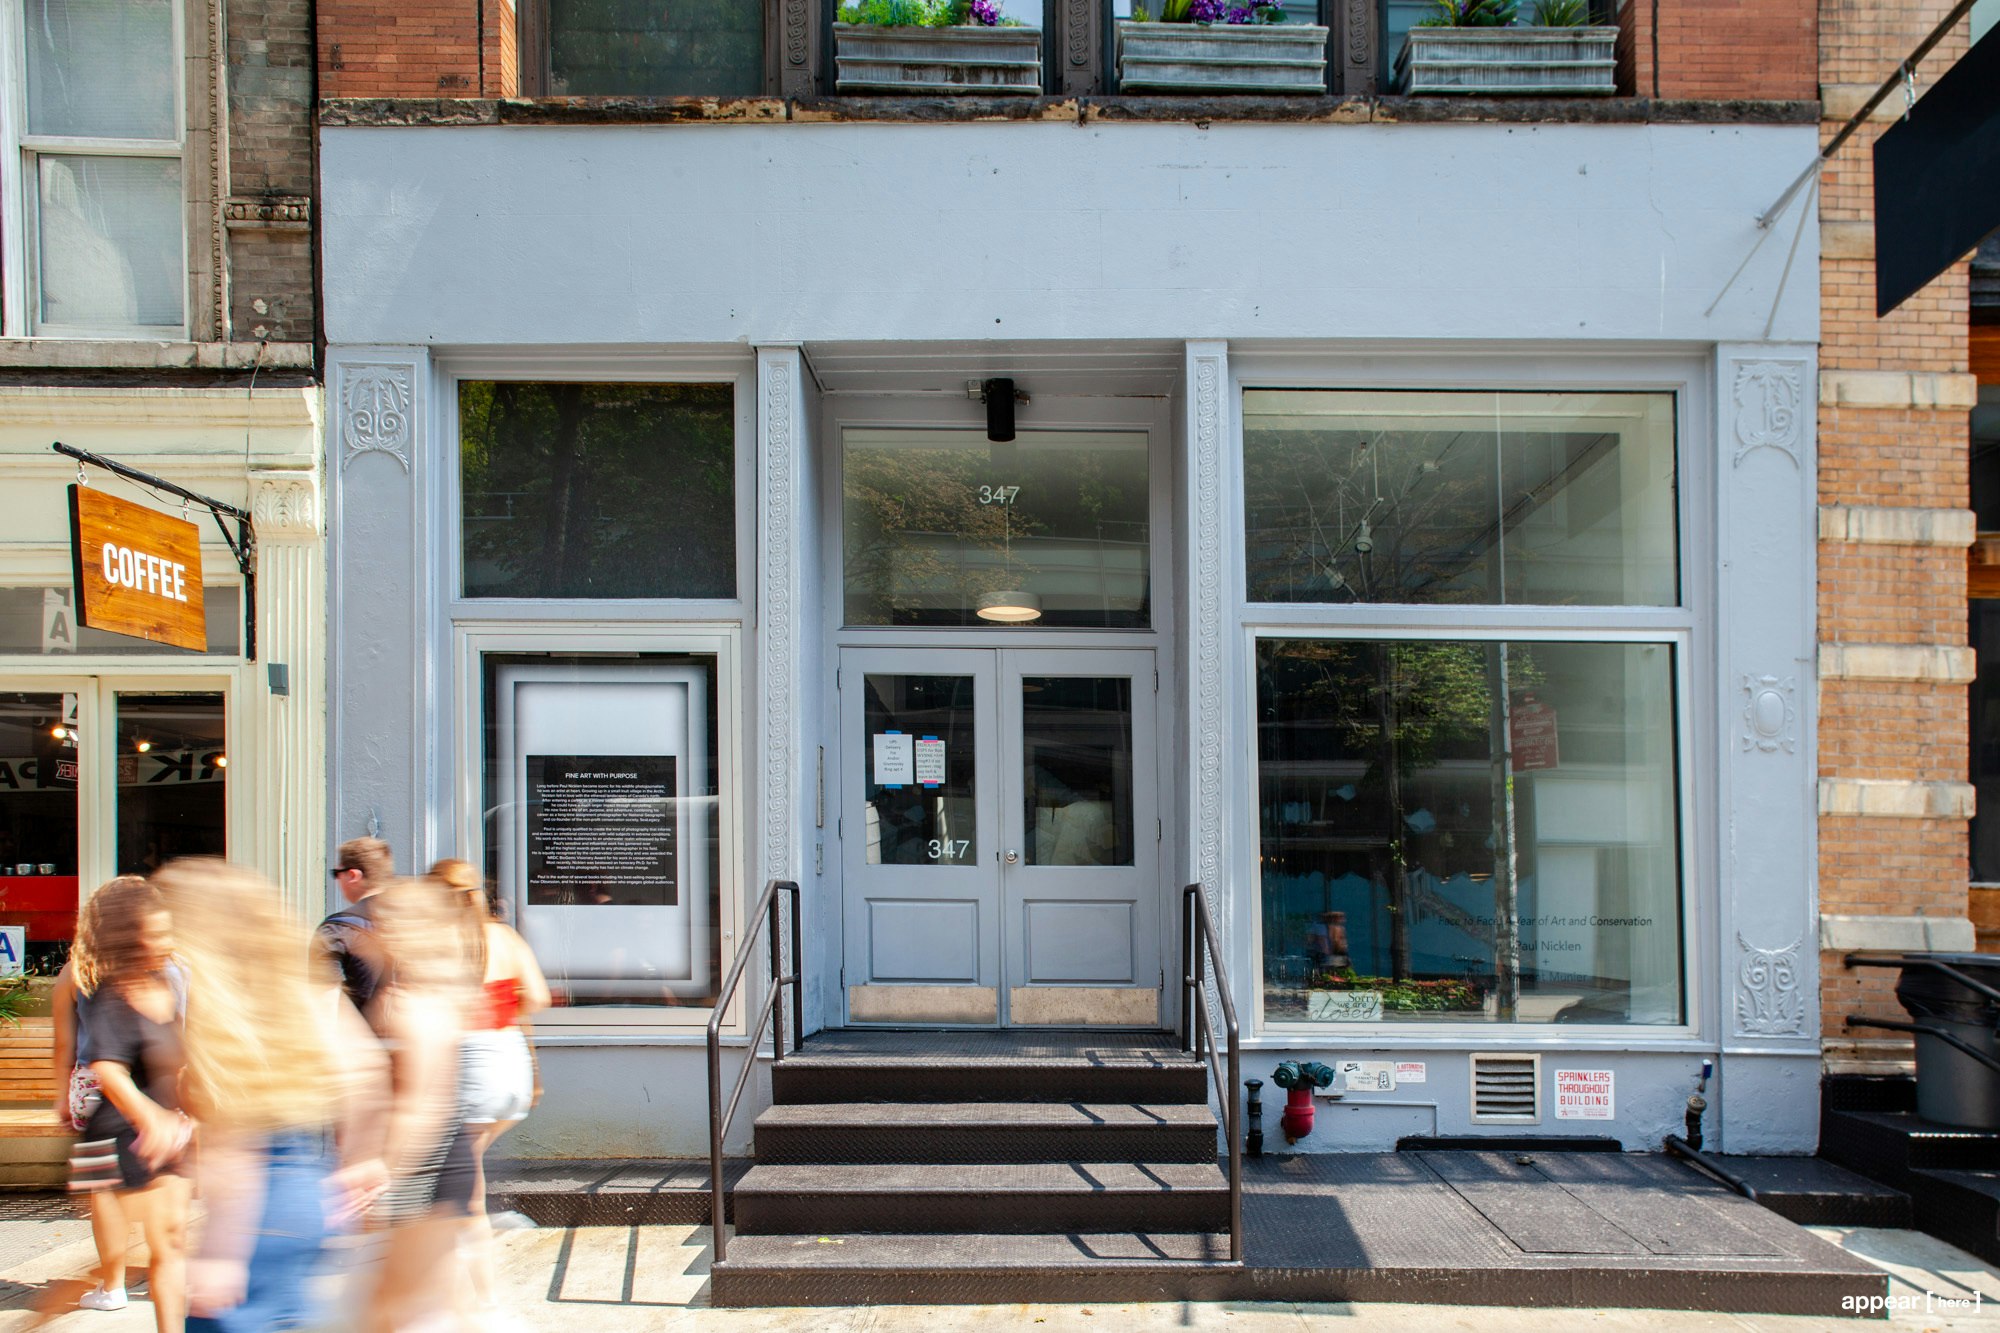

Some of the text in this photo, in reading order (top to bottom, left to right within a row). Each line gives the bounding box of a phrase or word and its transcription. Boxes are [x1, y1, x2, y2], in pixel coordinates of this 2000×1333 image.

[979, 485, 1020, 504] 347
[102, 542, 188, 603] COFFEE
[928, 839, 970, 859] 347
[1538, 916, 1550, 927] of
[1551, 915, 1566, 926] Art
[1569, 915, 1587, 926] and
[1589, 915, 1653, 927] Conservation
[1541, 940, 1582, 951] Nicklen
[1550, 971, 1588, 983] Munier
[1348, 991, 1375, 1004] Sorry
[1558, 1072, 1610, 1082] SPRINKLERS
[1558, 1083, 1610, 1094] THROUGHOUT
[1560, 1095, 1609, 1106] BUILDING
